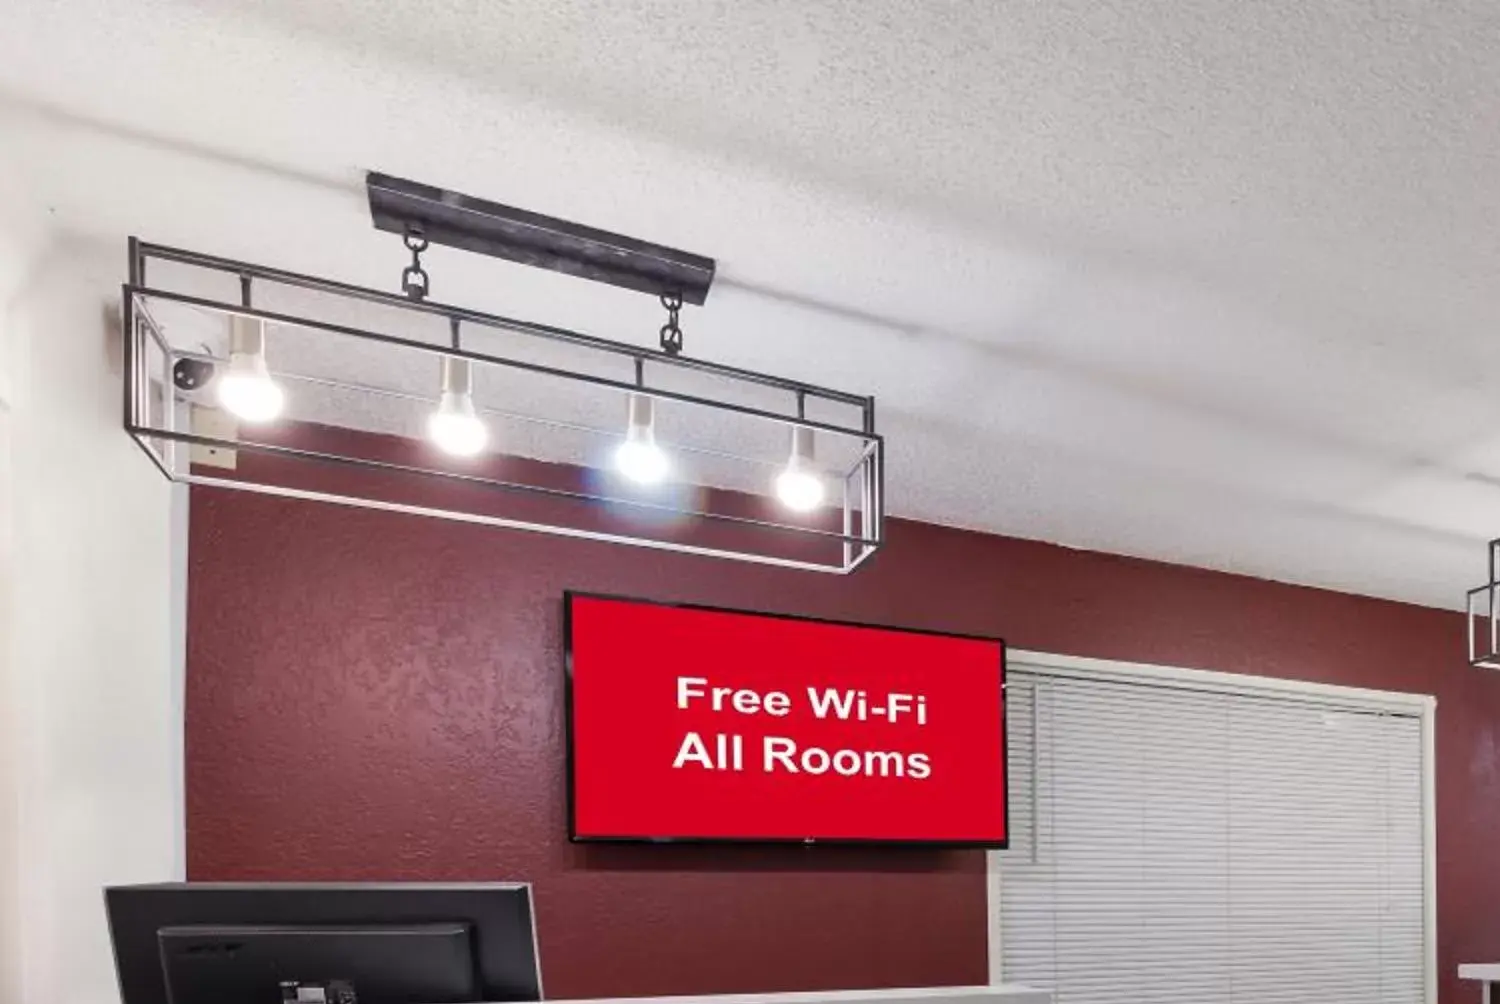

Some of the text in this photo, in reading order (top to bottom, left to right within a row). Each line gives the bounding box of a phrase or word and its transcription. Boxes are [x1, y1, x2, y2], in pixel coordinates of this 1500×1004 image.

[677, 676, 927, 726] Free Wi-Fi
[672, 731, 931, 779] All Rooms
